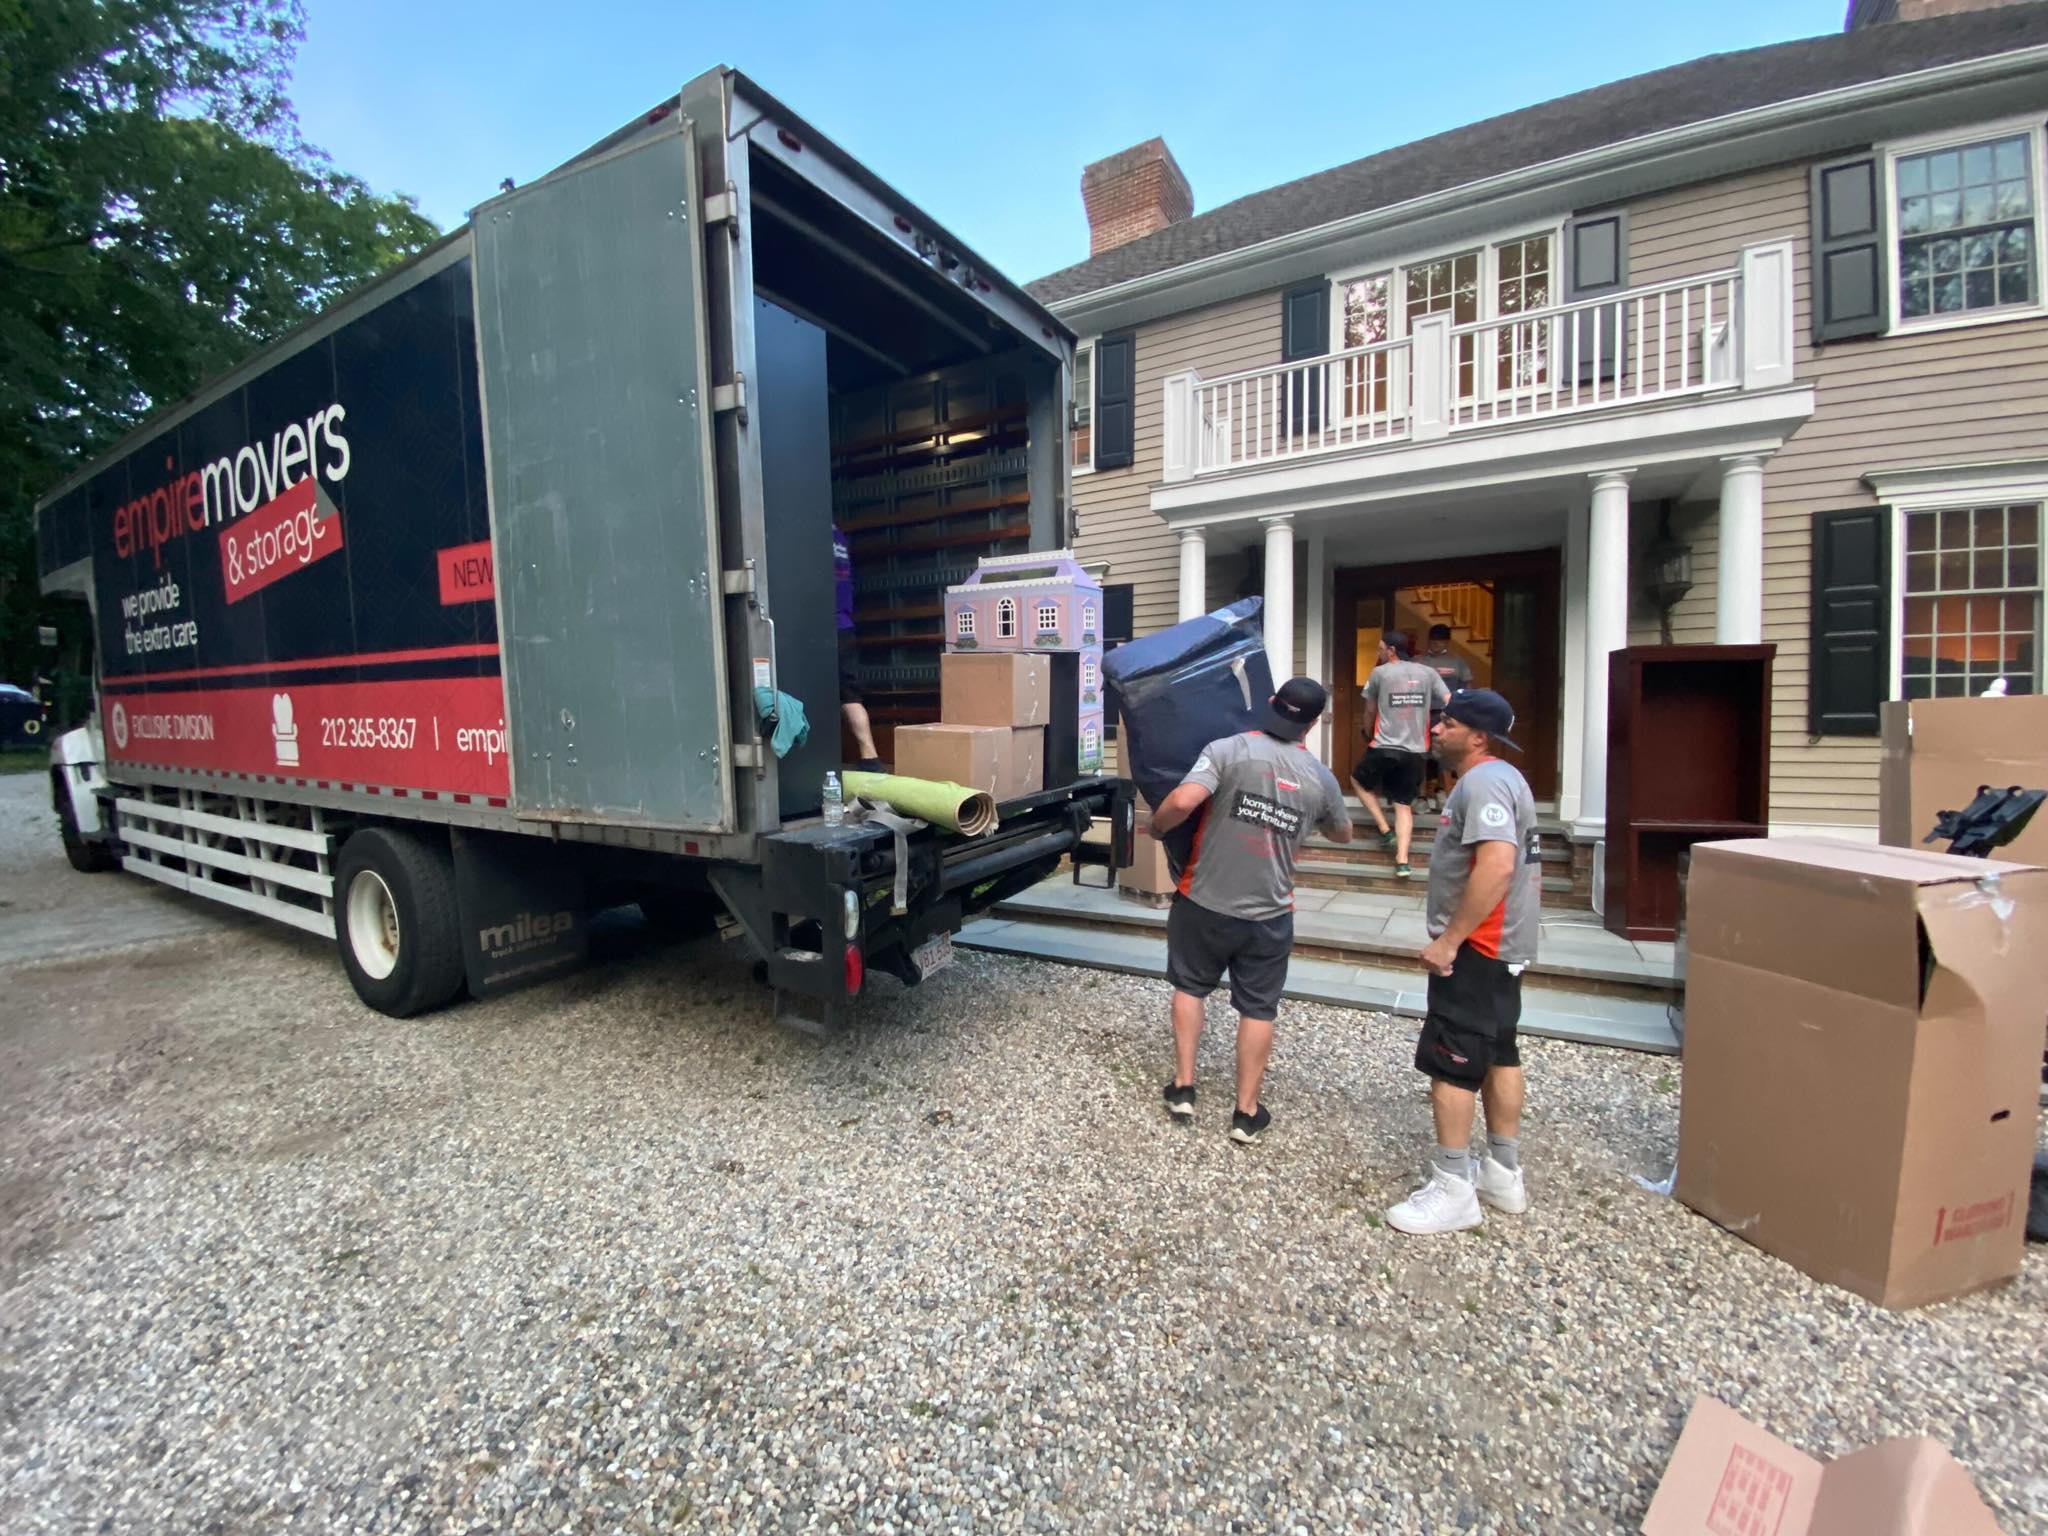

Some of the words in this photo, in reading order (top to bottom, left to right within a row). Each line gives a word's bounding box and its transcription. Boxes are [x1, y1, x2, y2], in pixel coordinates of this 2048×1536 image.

[228, 537, 246, 585] &
[246, 503, 326, 563] storage
[453, 556, 494, 589] NEW
[122, 595, 138, 619] we
[139, 573, 180, 626] provide
[125, 621, 142, 654] the
[143, 622, 172, 652] extra
[172, 620, 198, 648] care
[321, 717, 347, 747] 212
[349, 717, 416, 749] 365-8367
[1237, 806, 1260, 818] your
[480, 911, 573, 951] milea
